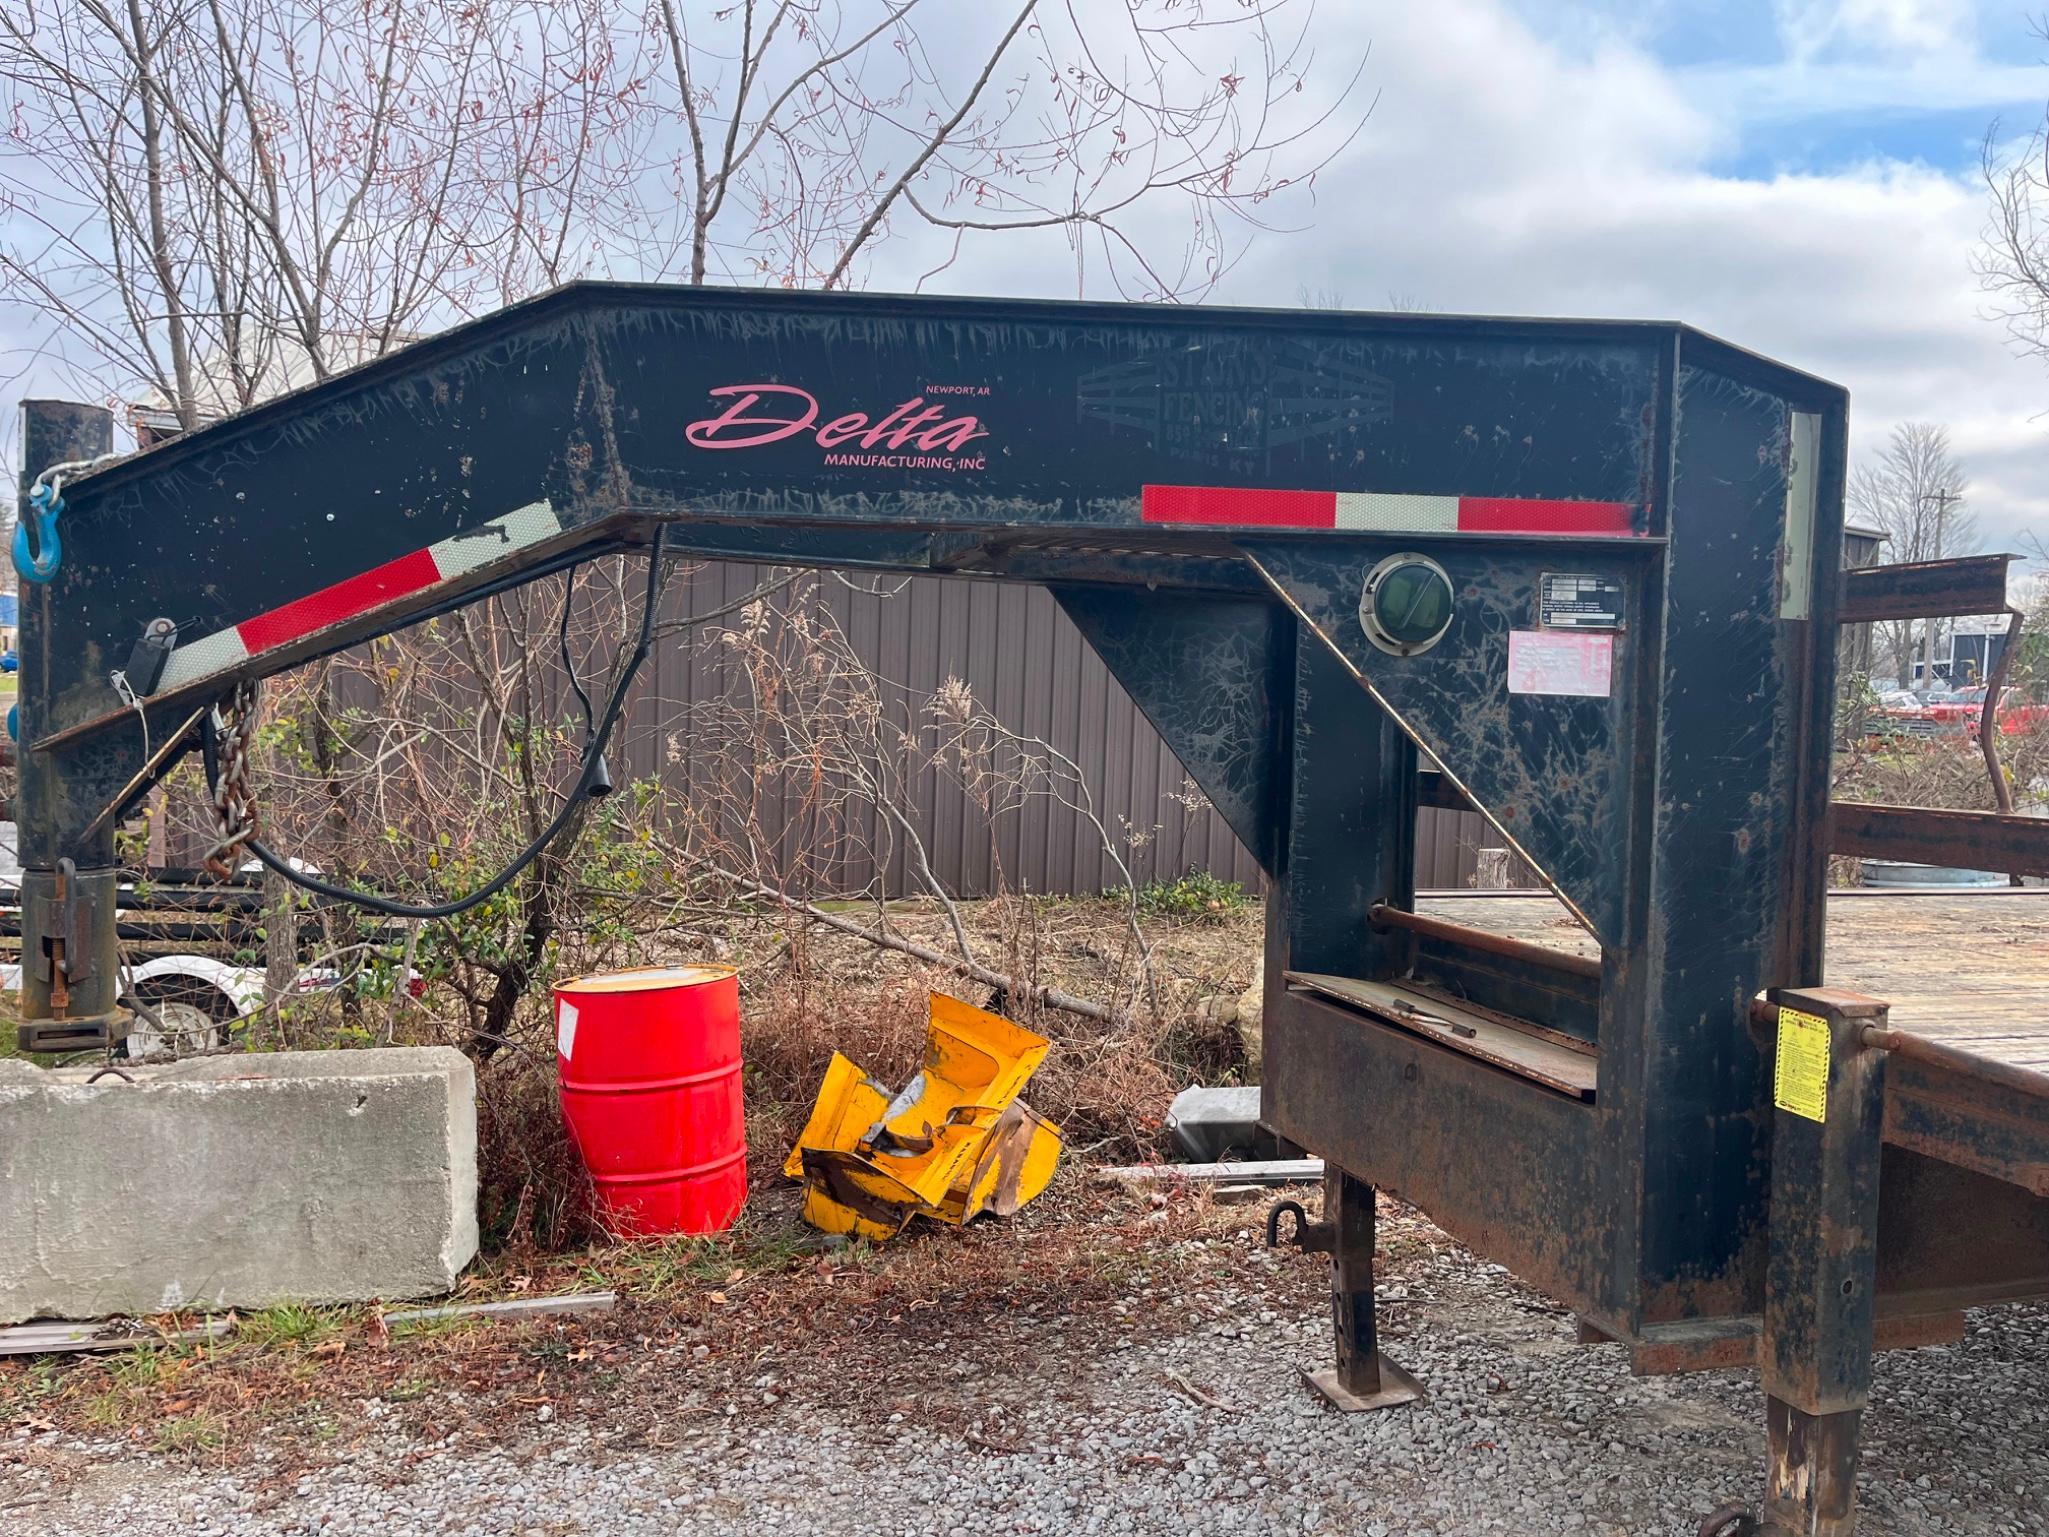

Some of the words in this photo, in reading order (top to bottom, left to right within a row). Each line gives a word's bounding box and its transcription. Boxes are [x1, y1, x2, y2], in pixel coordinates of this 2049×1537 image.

[685, 383, 989, 452] Delta
[824, 454, 956, 472] MANUFACTURING,
[958, 457, 986, 470] INC
